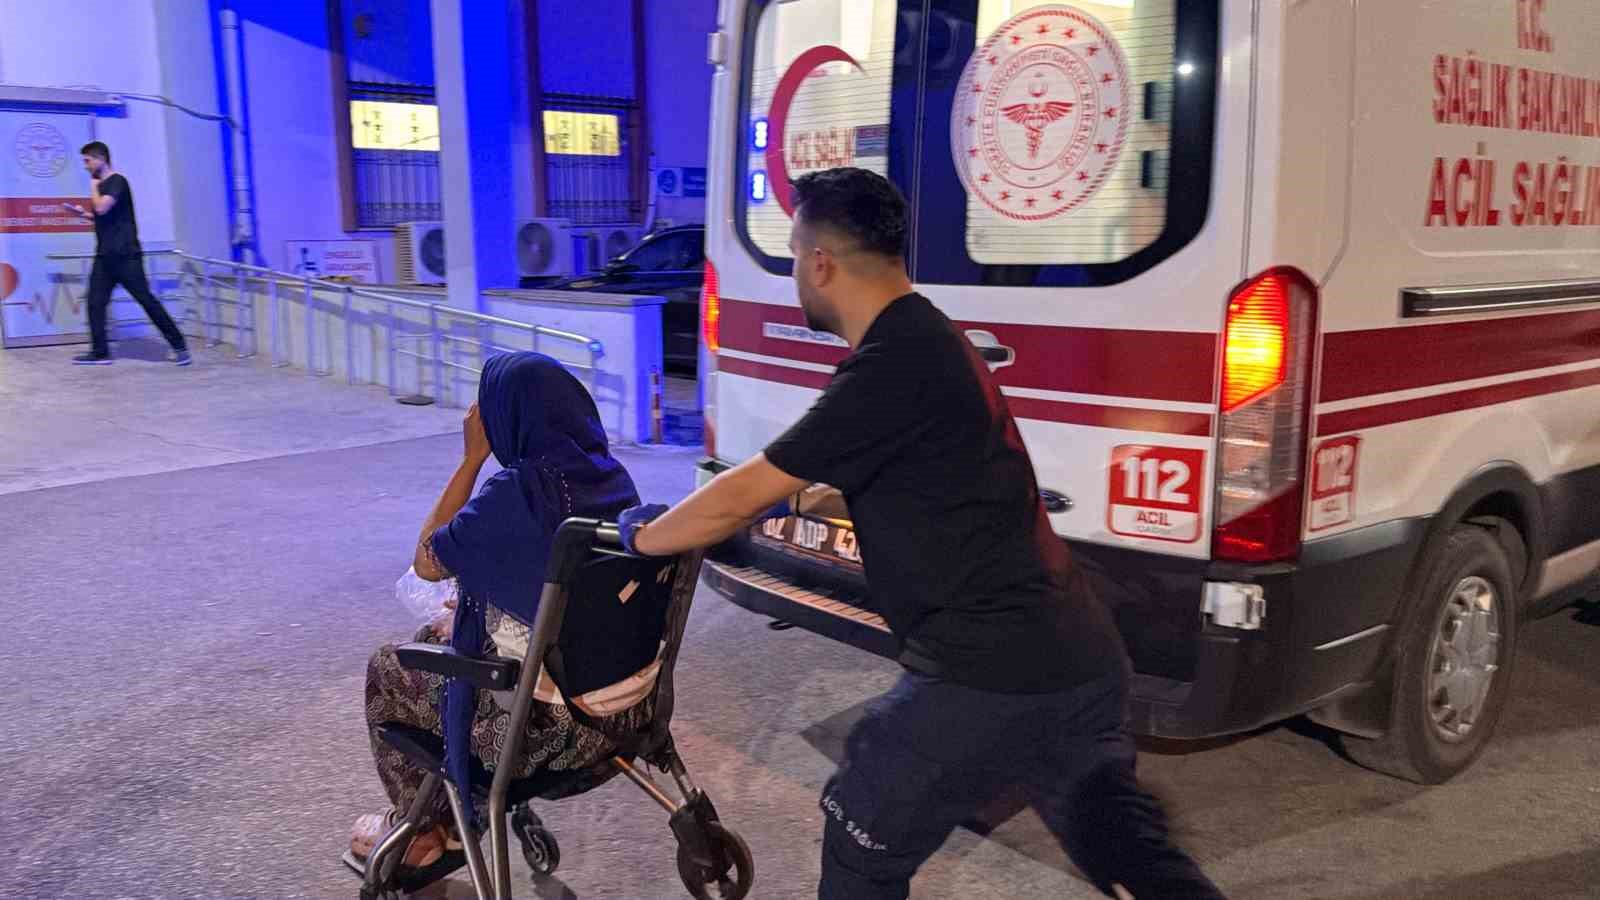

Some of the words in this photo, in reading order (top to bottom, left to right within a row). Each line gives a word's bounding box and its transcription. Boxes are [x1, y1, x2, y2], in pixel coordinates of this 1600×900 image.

[1424, 141, 1501, 227] ACİL
[1120, 456, 1190, 504] 112
[1316, 444, 1354, 492] 112
[792, 517, 828, 551] ADP
